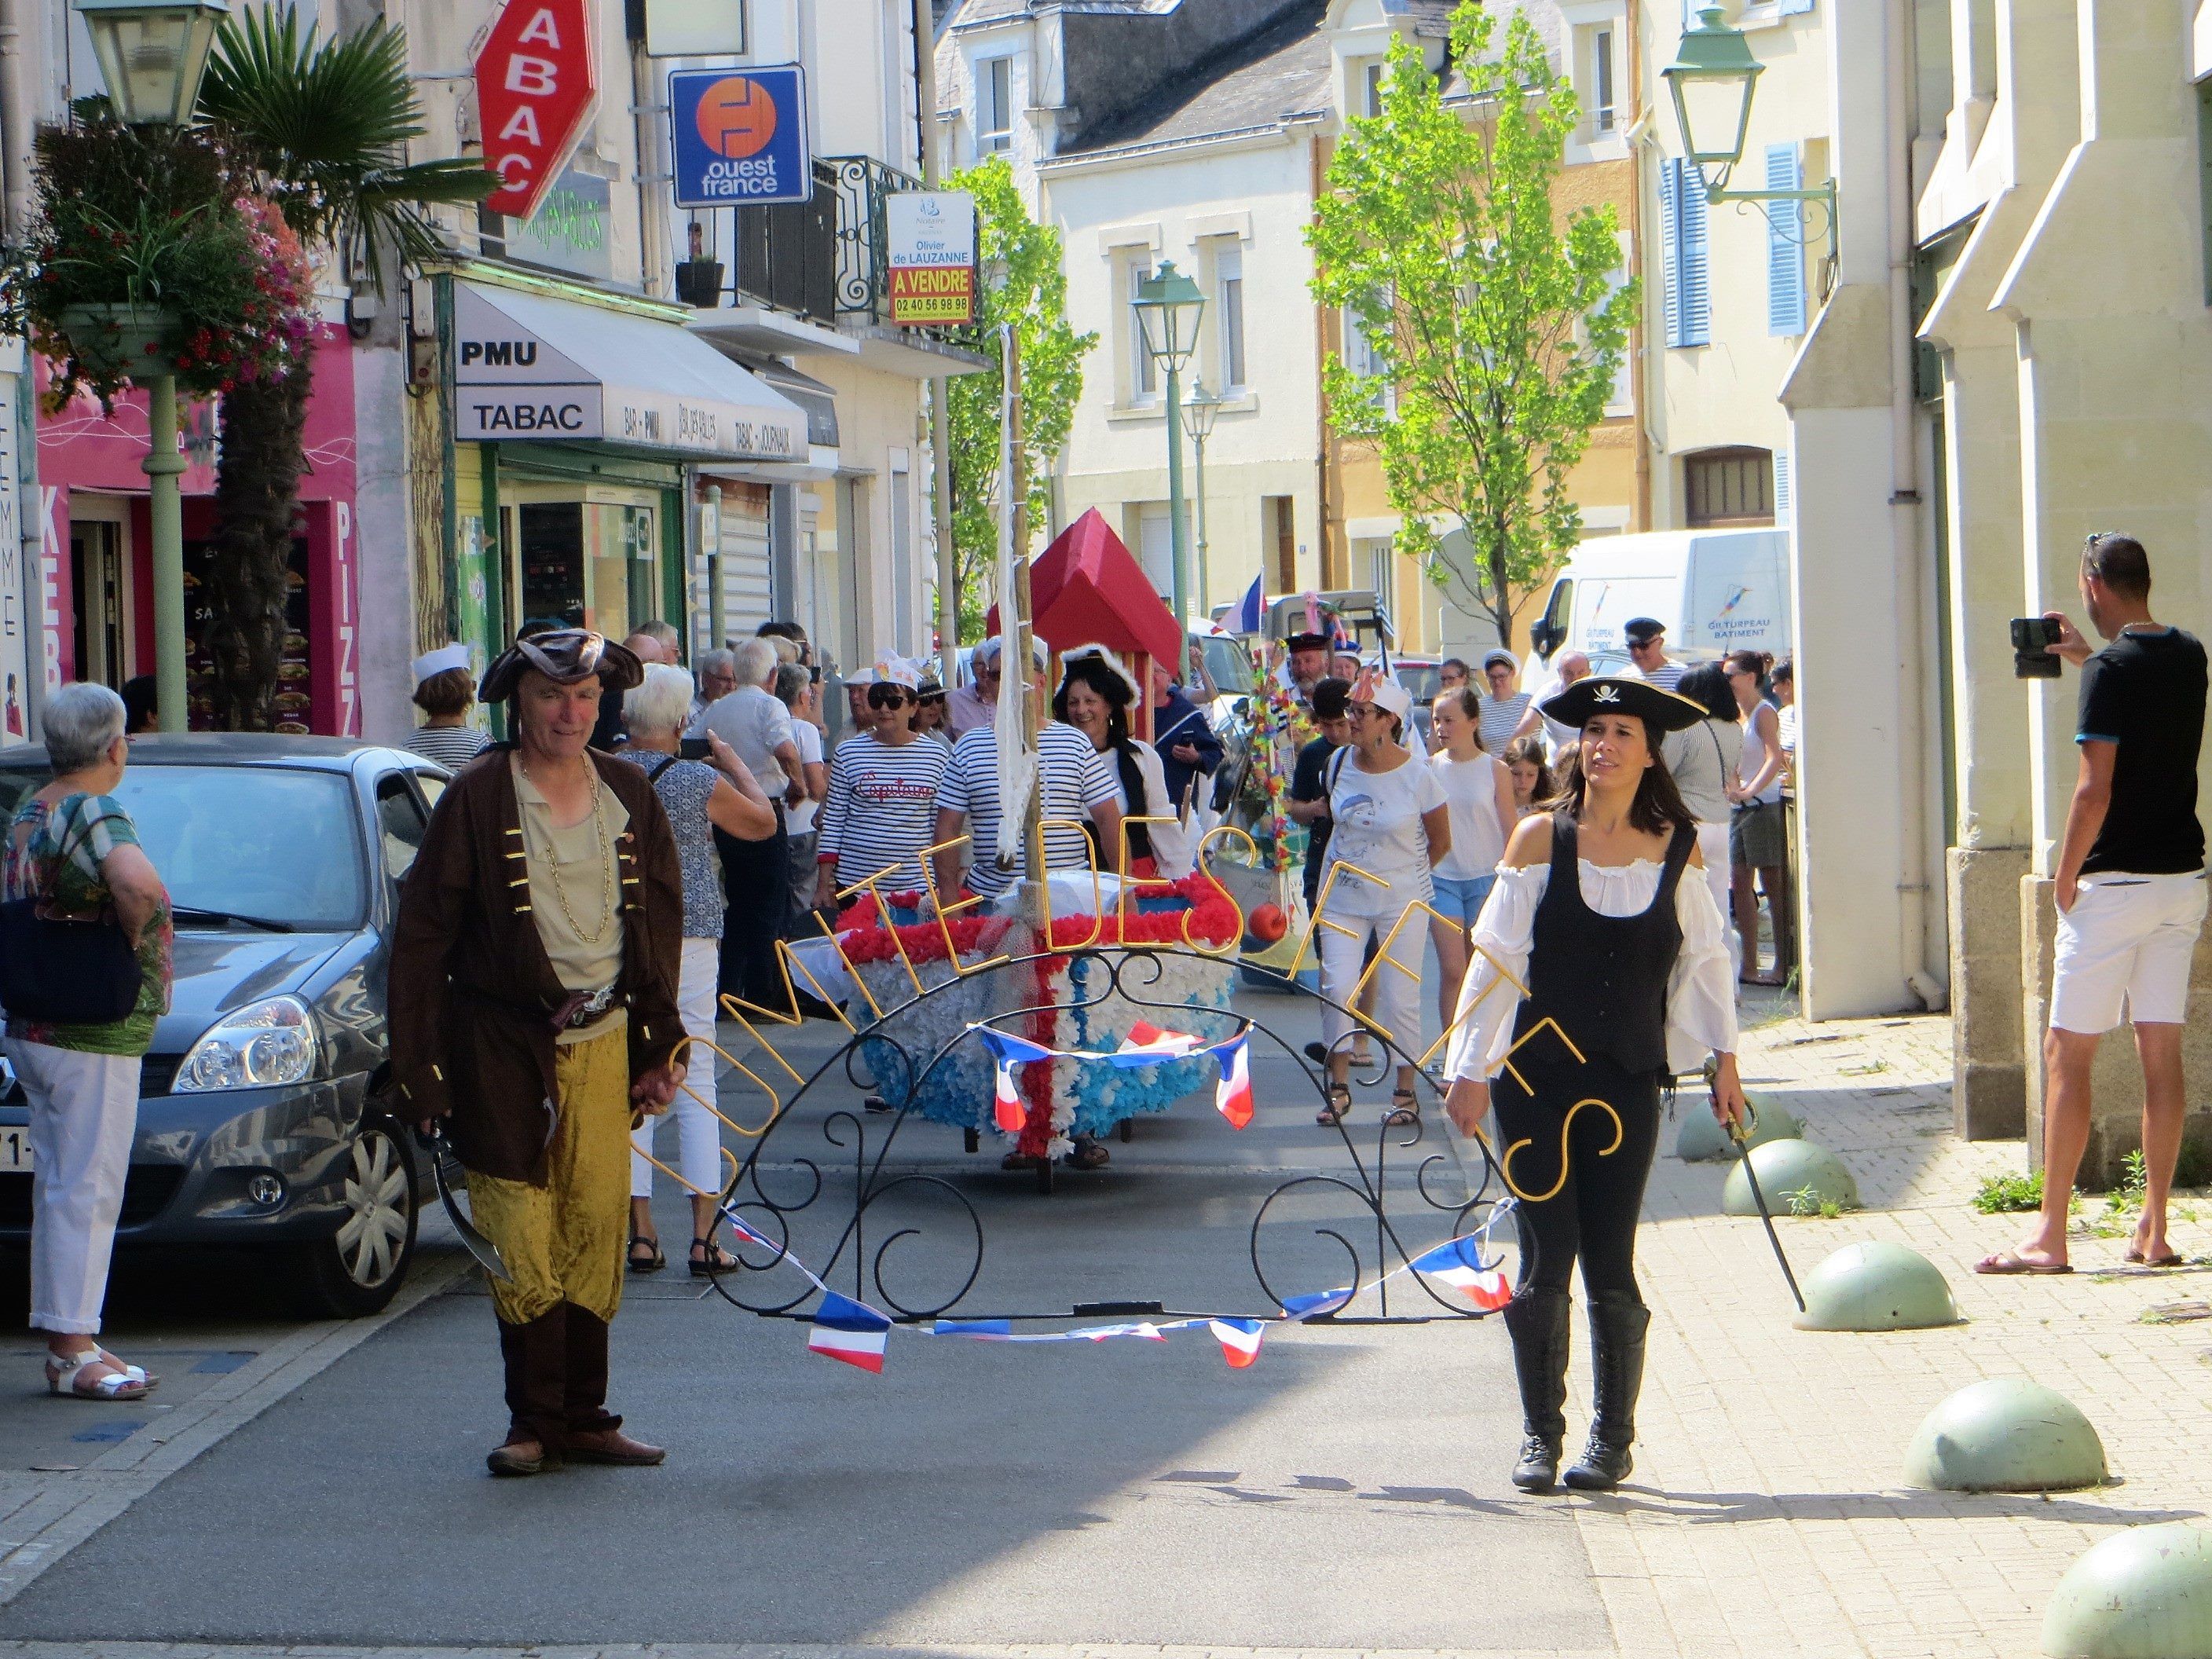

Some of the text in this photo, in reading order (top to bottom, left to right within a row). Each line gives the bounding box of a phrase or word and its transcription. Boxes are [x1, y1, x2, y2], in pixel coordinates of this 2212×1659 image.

[709, 155, 775, 179] ouest
[701, 175, 777, 196] france
[917, 240, 945, 251] Olivier
[894, 252, 969, 264] de LAUZANNE
[895, 270, 969, 293] A VENDRE
[896, 298, 967, 311] 02 40 56 98 98
[462, 342, 537, 366] PMU
[473, 404, 583, 430] TABAC
[624, 406, 637, 438] BAR
[1037, 815, 1258, 955] DES
